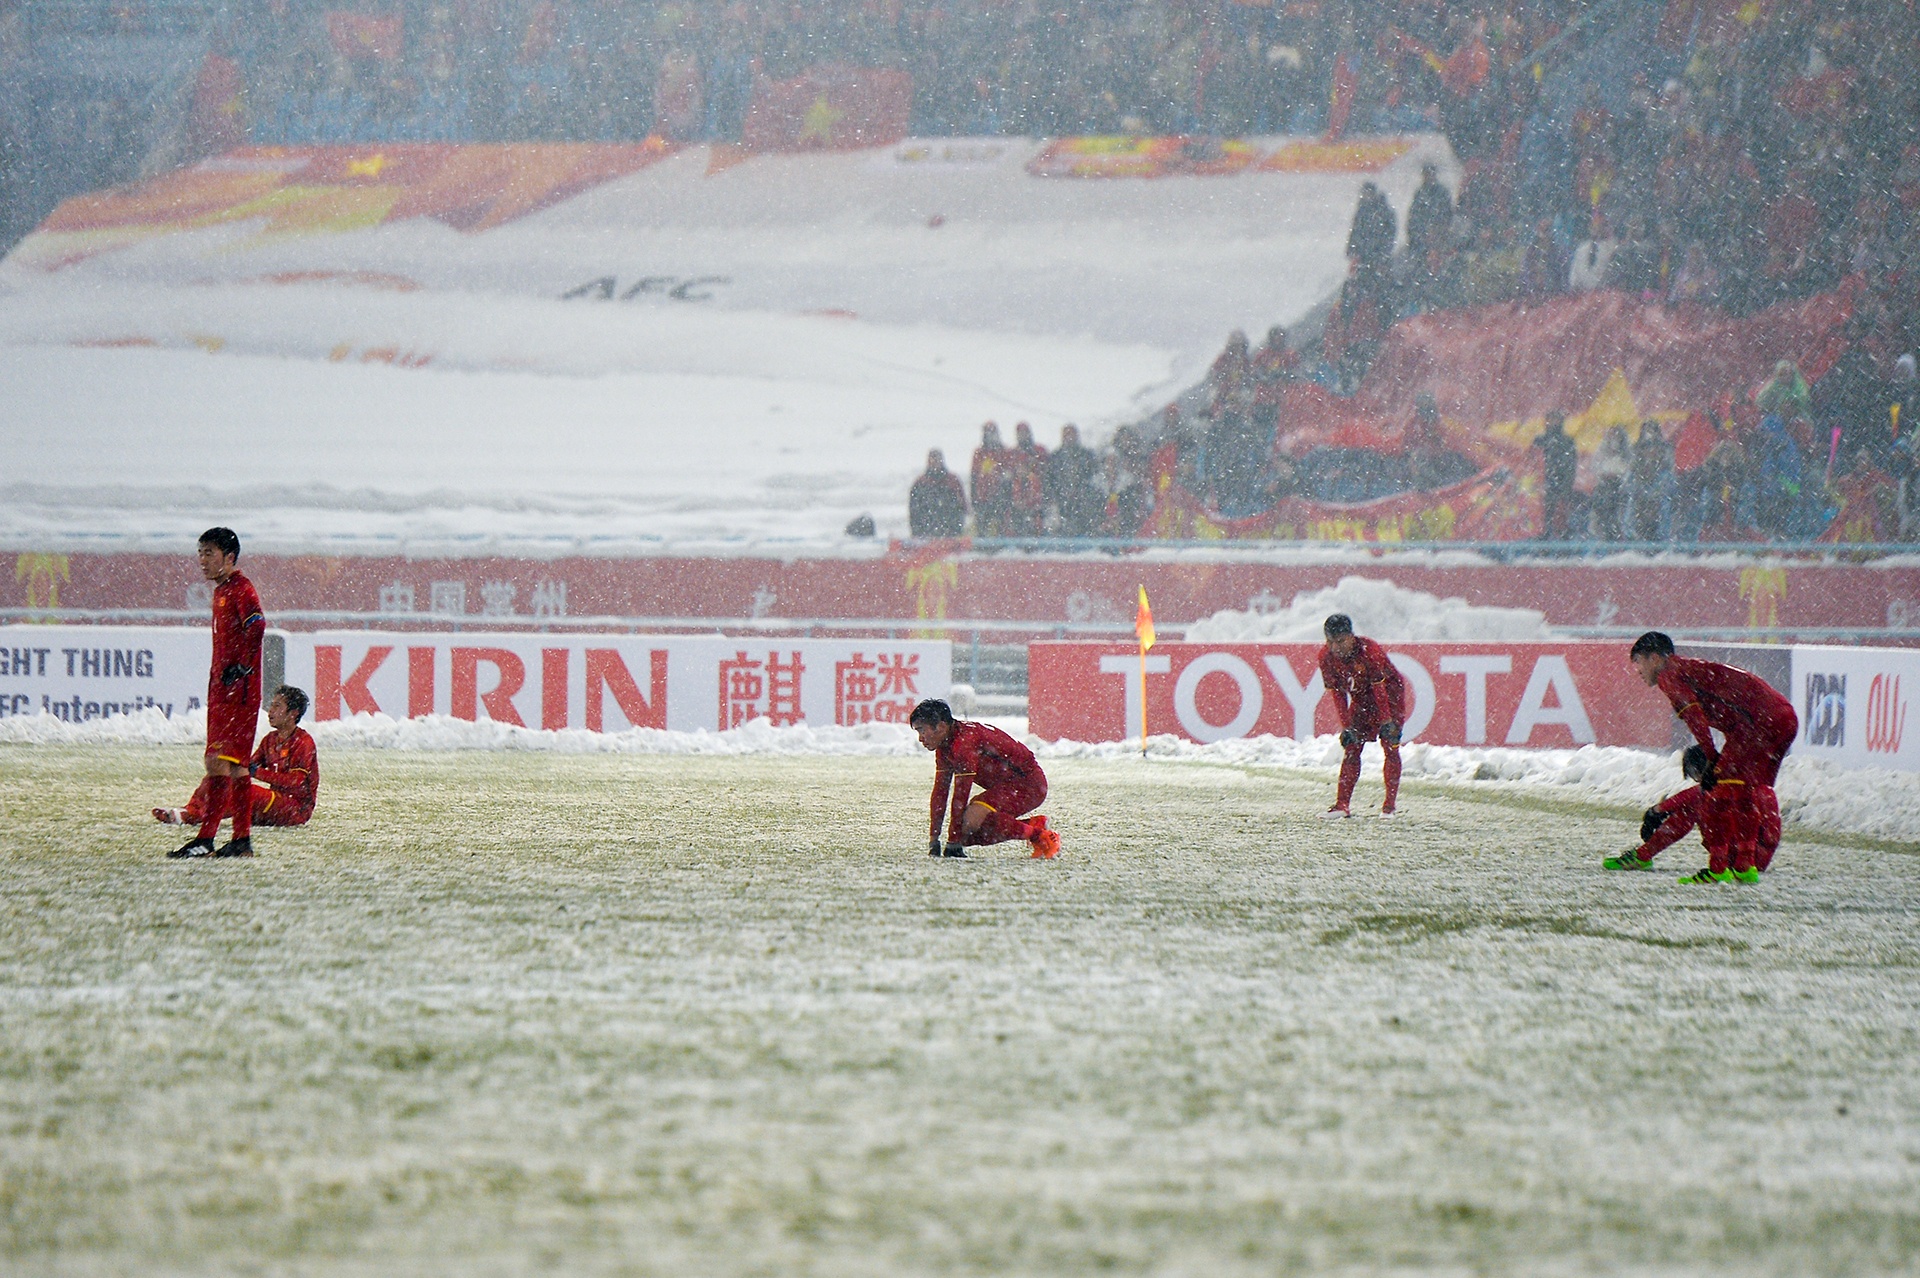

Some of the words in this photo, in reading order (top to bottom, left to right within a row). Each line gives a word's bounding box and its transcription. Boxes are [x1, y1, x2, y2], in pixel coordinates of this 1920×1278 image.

[558, 275, 731, 301] AFC
[62, 648, 154, 678] THING
[314, 645, 669, 733] KIRIN
